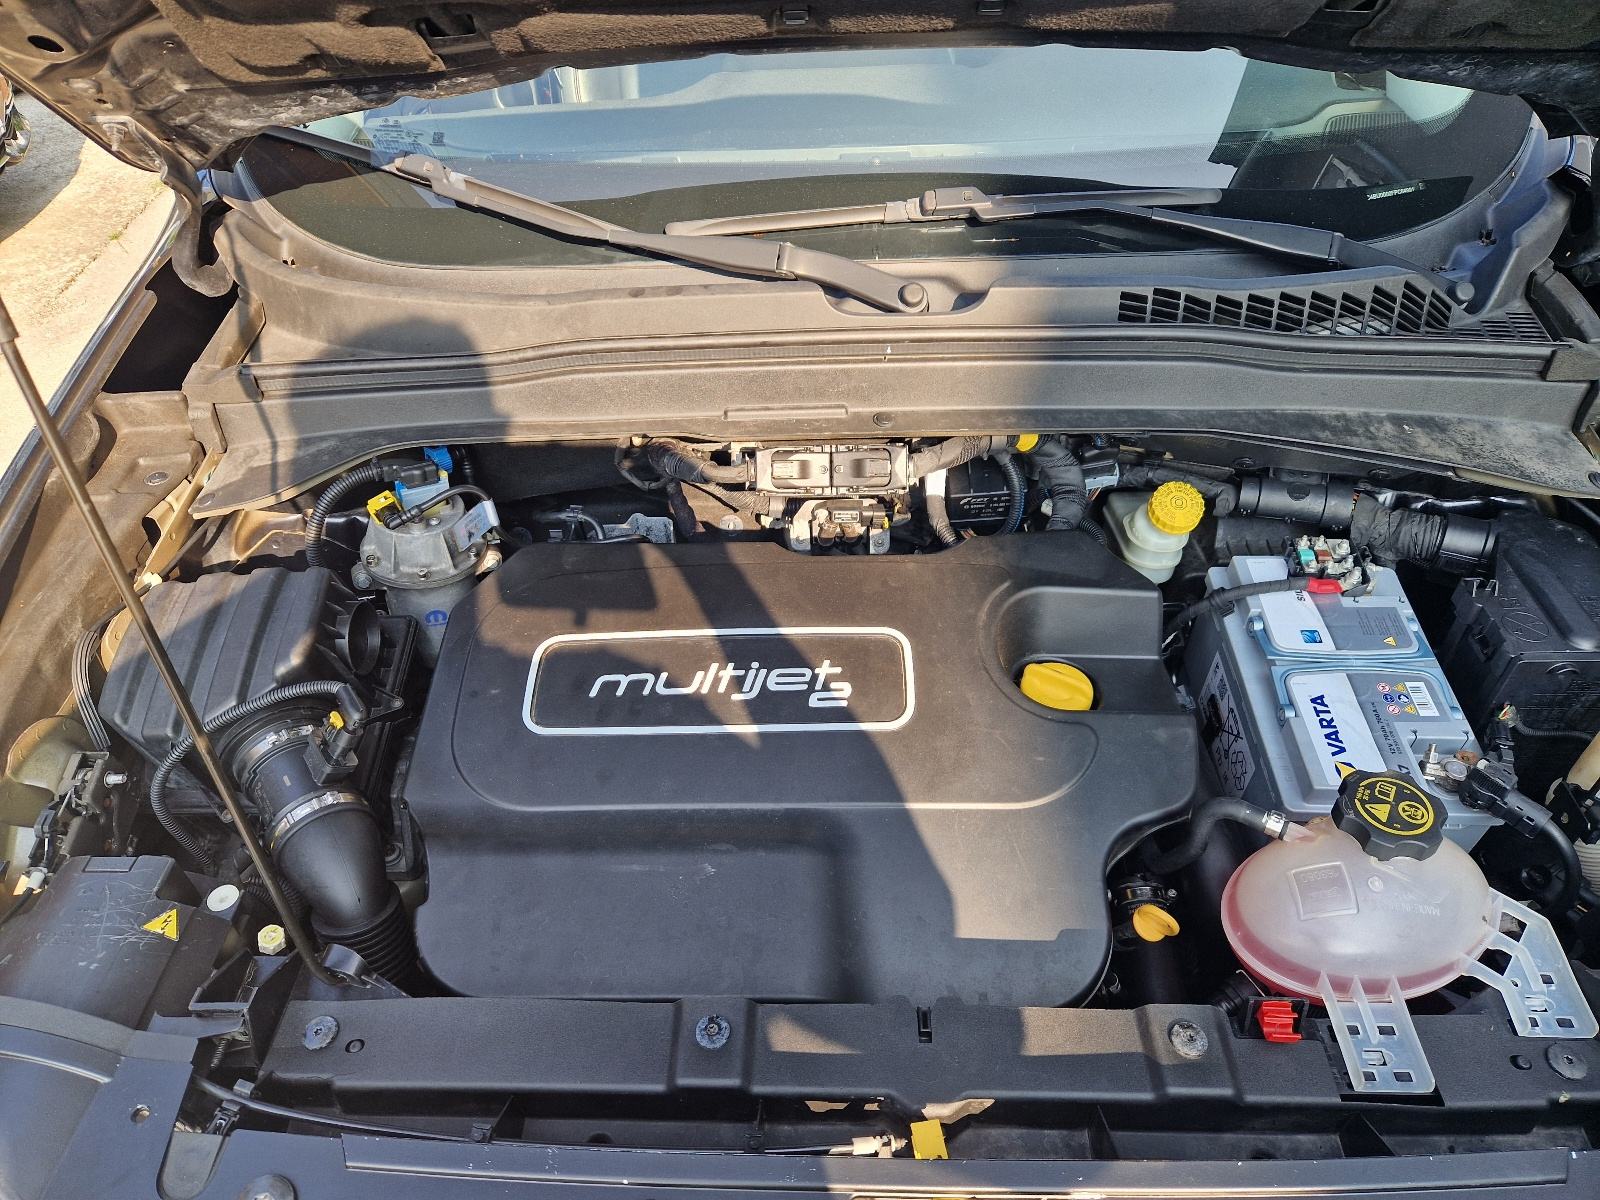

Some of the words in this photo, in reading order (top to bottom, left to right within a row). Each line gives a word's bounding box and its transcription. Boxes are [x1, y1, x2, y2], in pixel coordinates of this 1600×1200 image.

[1296, 589, 1306, 602] SIL
[588, 659, 843, 701] multijet
[1309, 694, 1347, 757] VARTA
